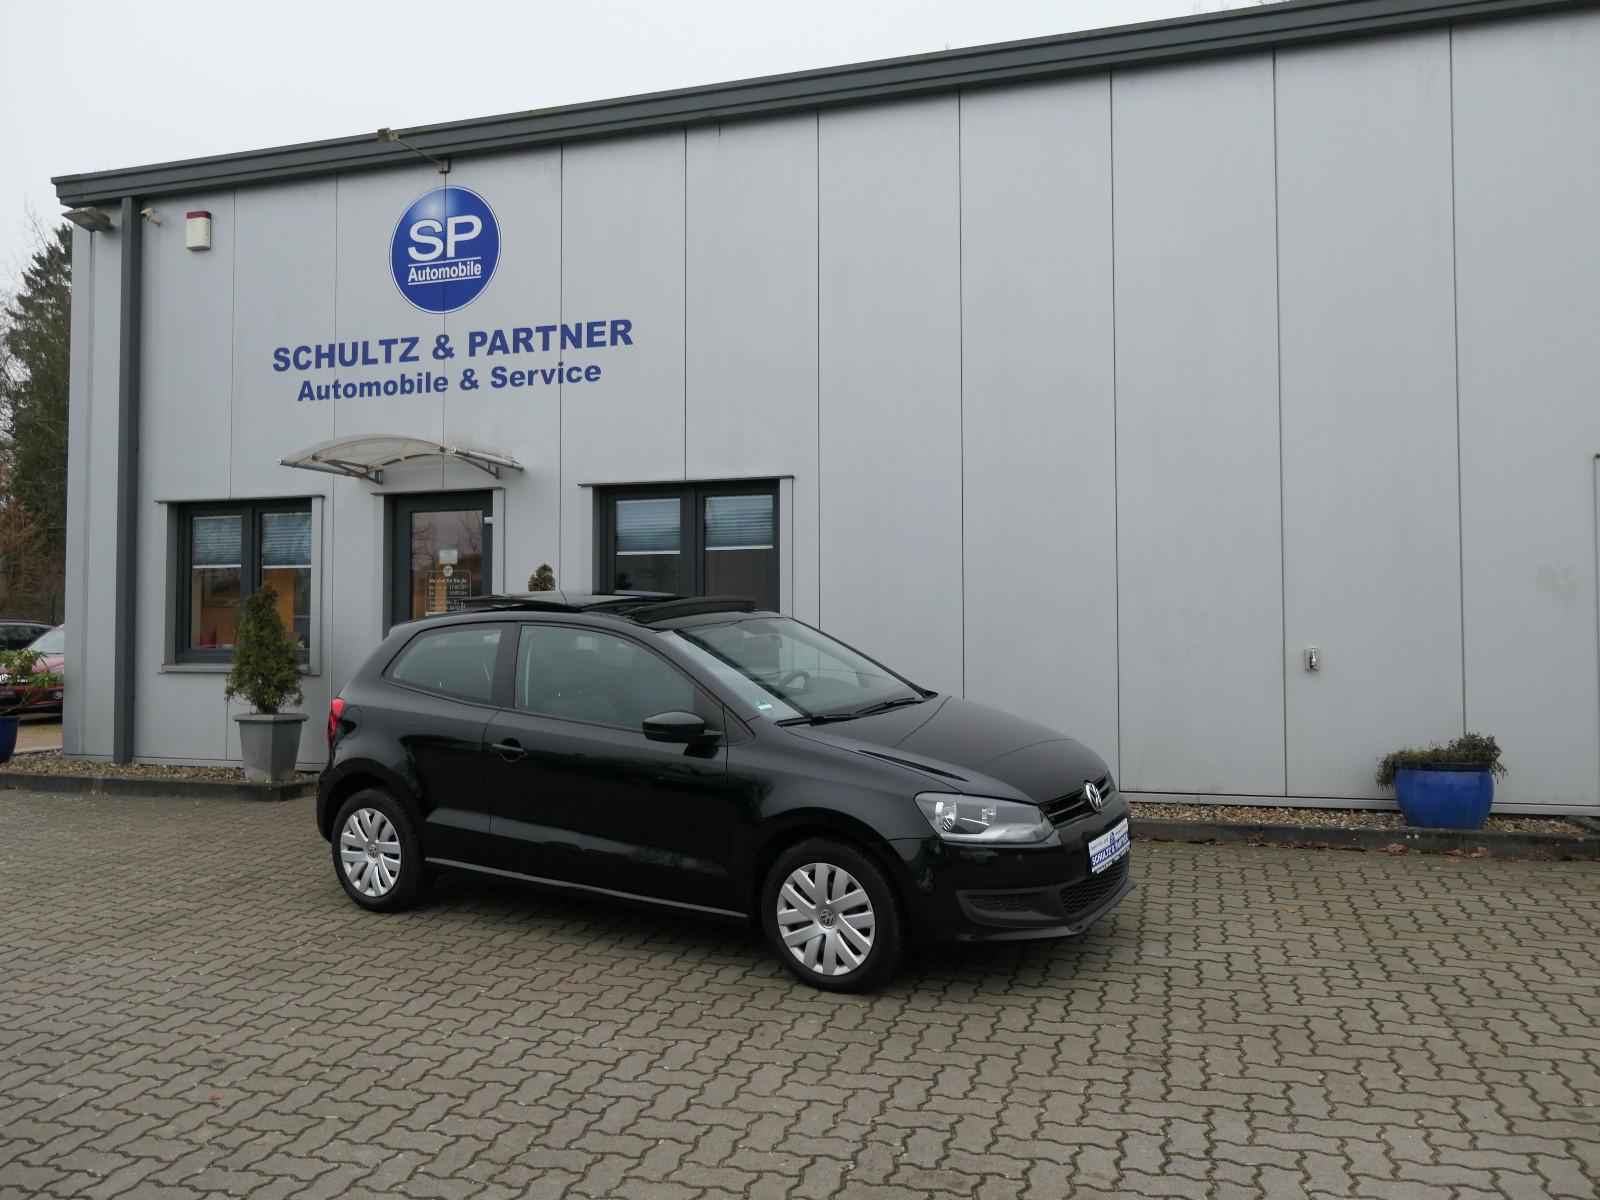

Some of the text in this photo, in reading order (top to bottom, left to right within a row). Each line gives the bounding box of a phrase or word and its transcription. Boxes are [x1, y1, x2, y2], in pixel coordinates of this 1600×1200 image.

[407, 214, 483, 262] SP
[407, 260, 482, 284] Automobile
[272, 319, 634, 373] SCHULTZ & PARTNER
[297, 361, 602, 402] Automobile & Service
